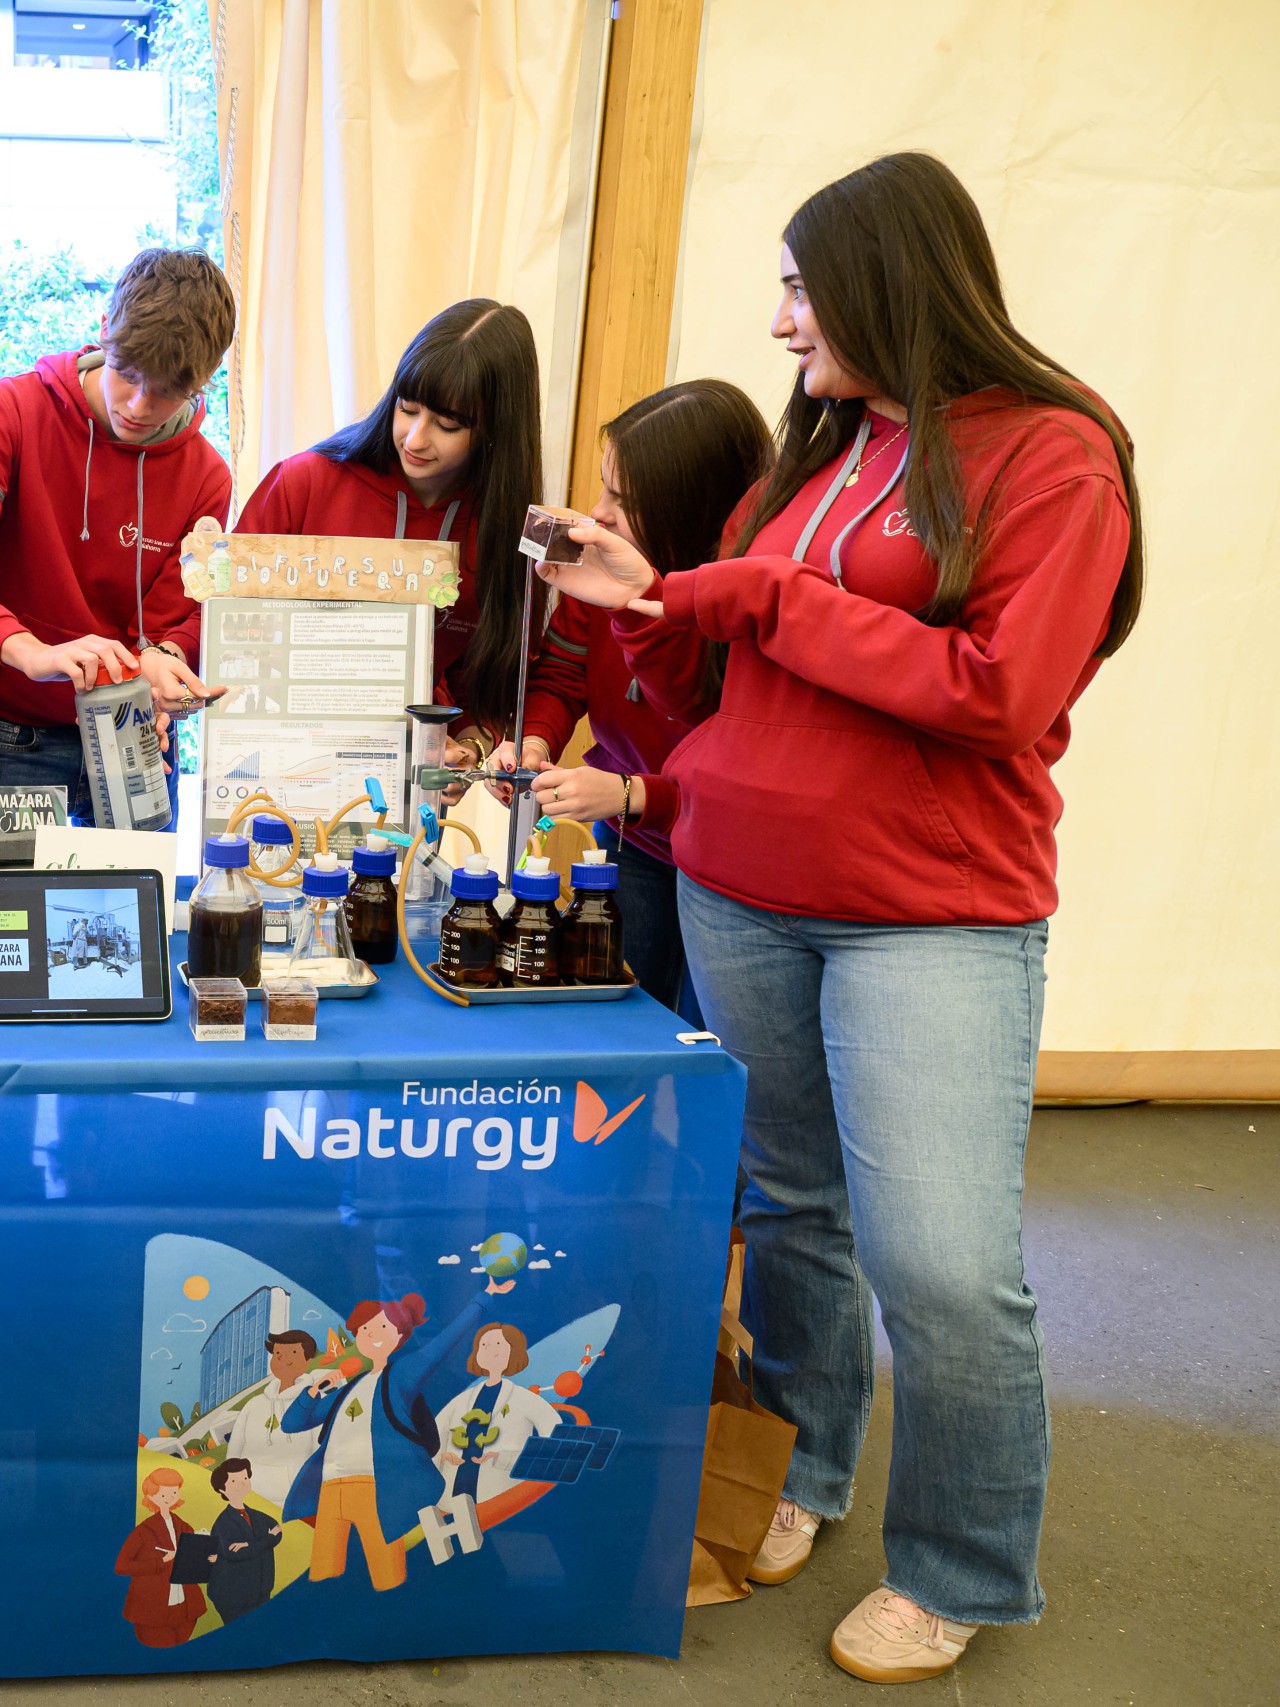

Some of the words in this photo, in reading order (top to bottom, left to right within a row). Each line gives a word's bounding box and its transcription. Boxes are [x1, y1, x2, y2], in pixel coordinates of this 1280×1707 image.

[312, 601, 363, 609] EXPERIMENTAL
[140, 724, 150, 738] 24
[266, 917, 287, 925] 500ml
[450, 931, 461, 939] 200
[449, 957, 460, 965] 100
[402, 1078, 561, 1106] Fundación
[262, 1107, 559, 1171] Naturgy
